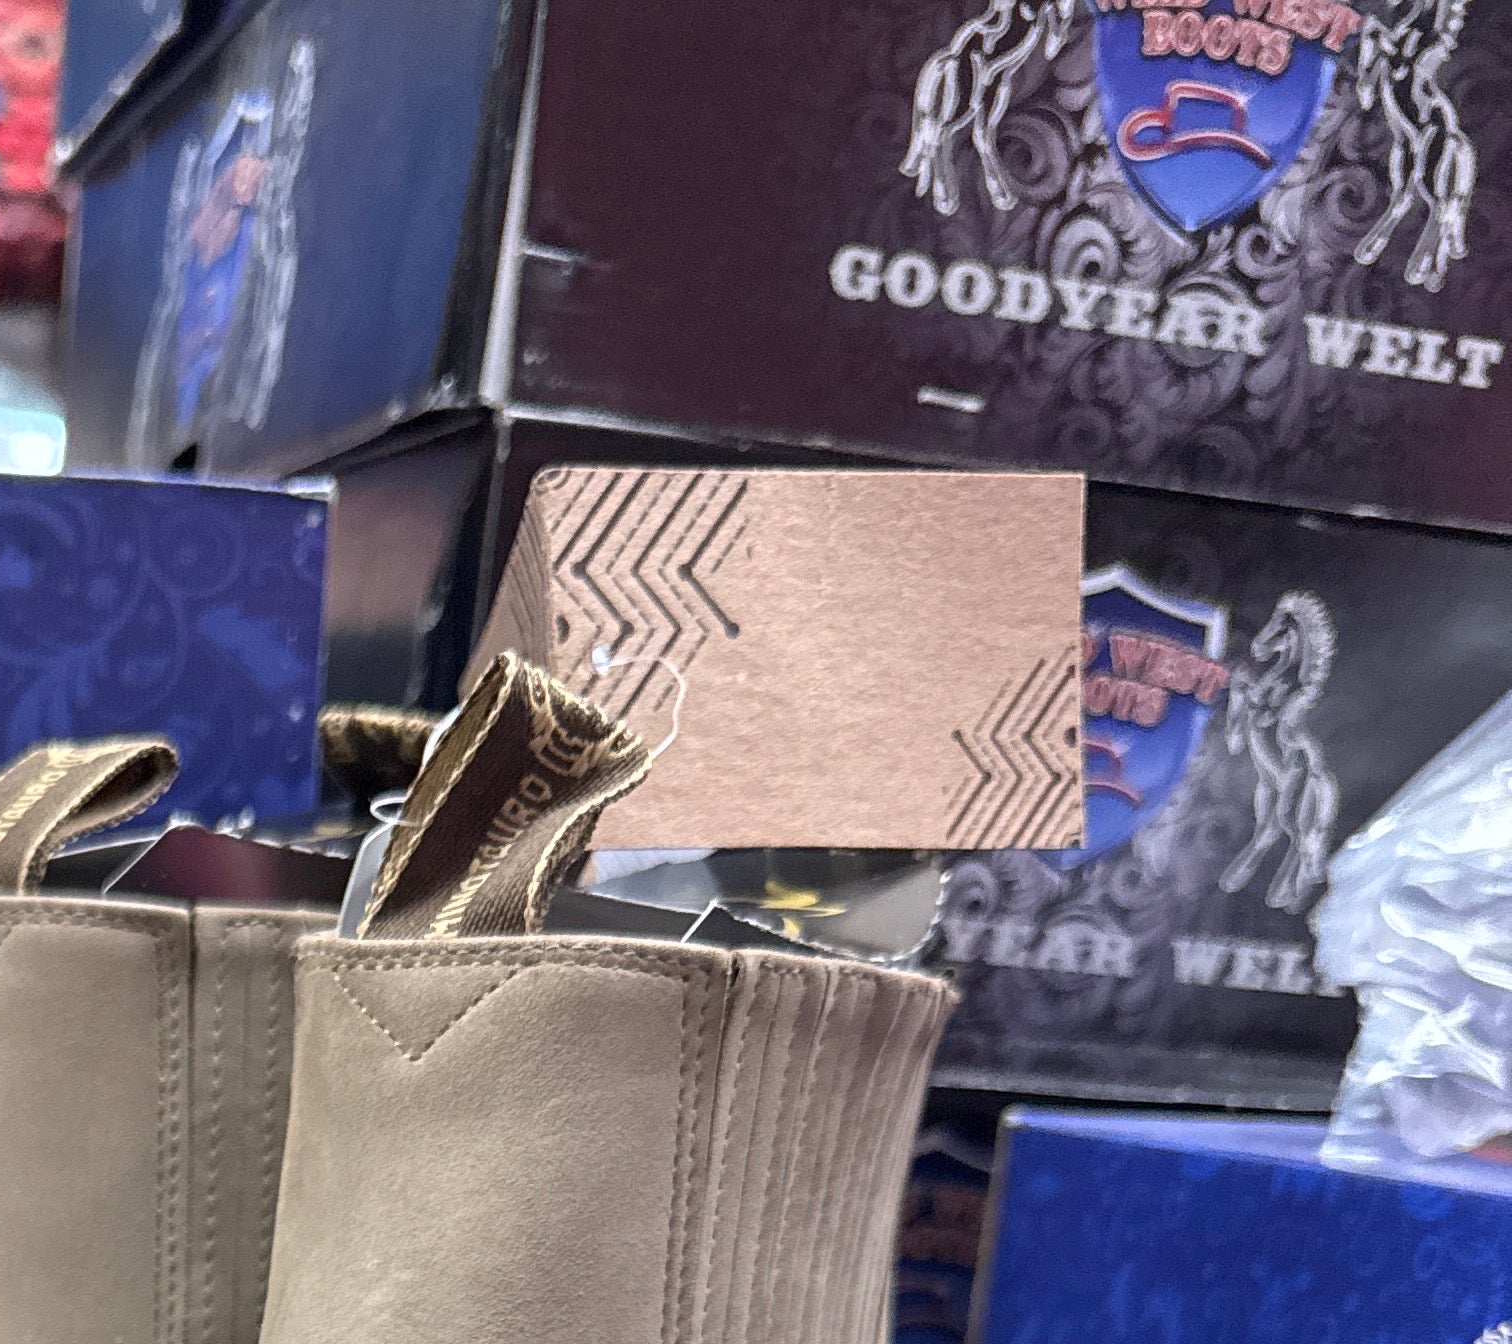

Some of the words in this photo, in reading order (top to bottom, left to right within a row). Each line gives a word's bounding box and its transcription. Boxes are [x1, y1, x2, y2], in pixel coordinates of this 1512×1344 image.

[1141, 8, 1294, 76] BOOTS
[828, 244, 1268, 356] GOODYEAR
[1303, 312, 1504, 389] WELT
[1172, 938, 1345, 998] WEL
